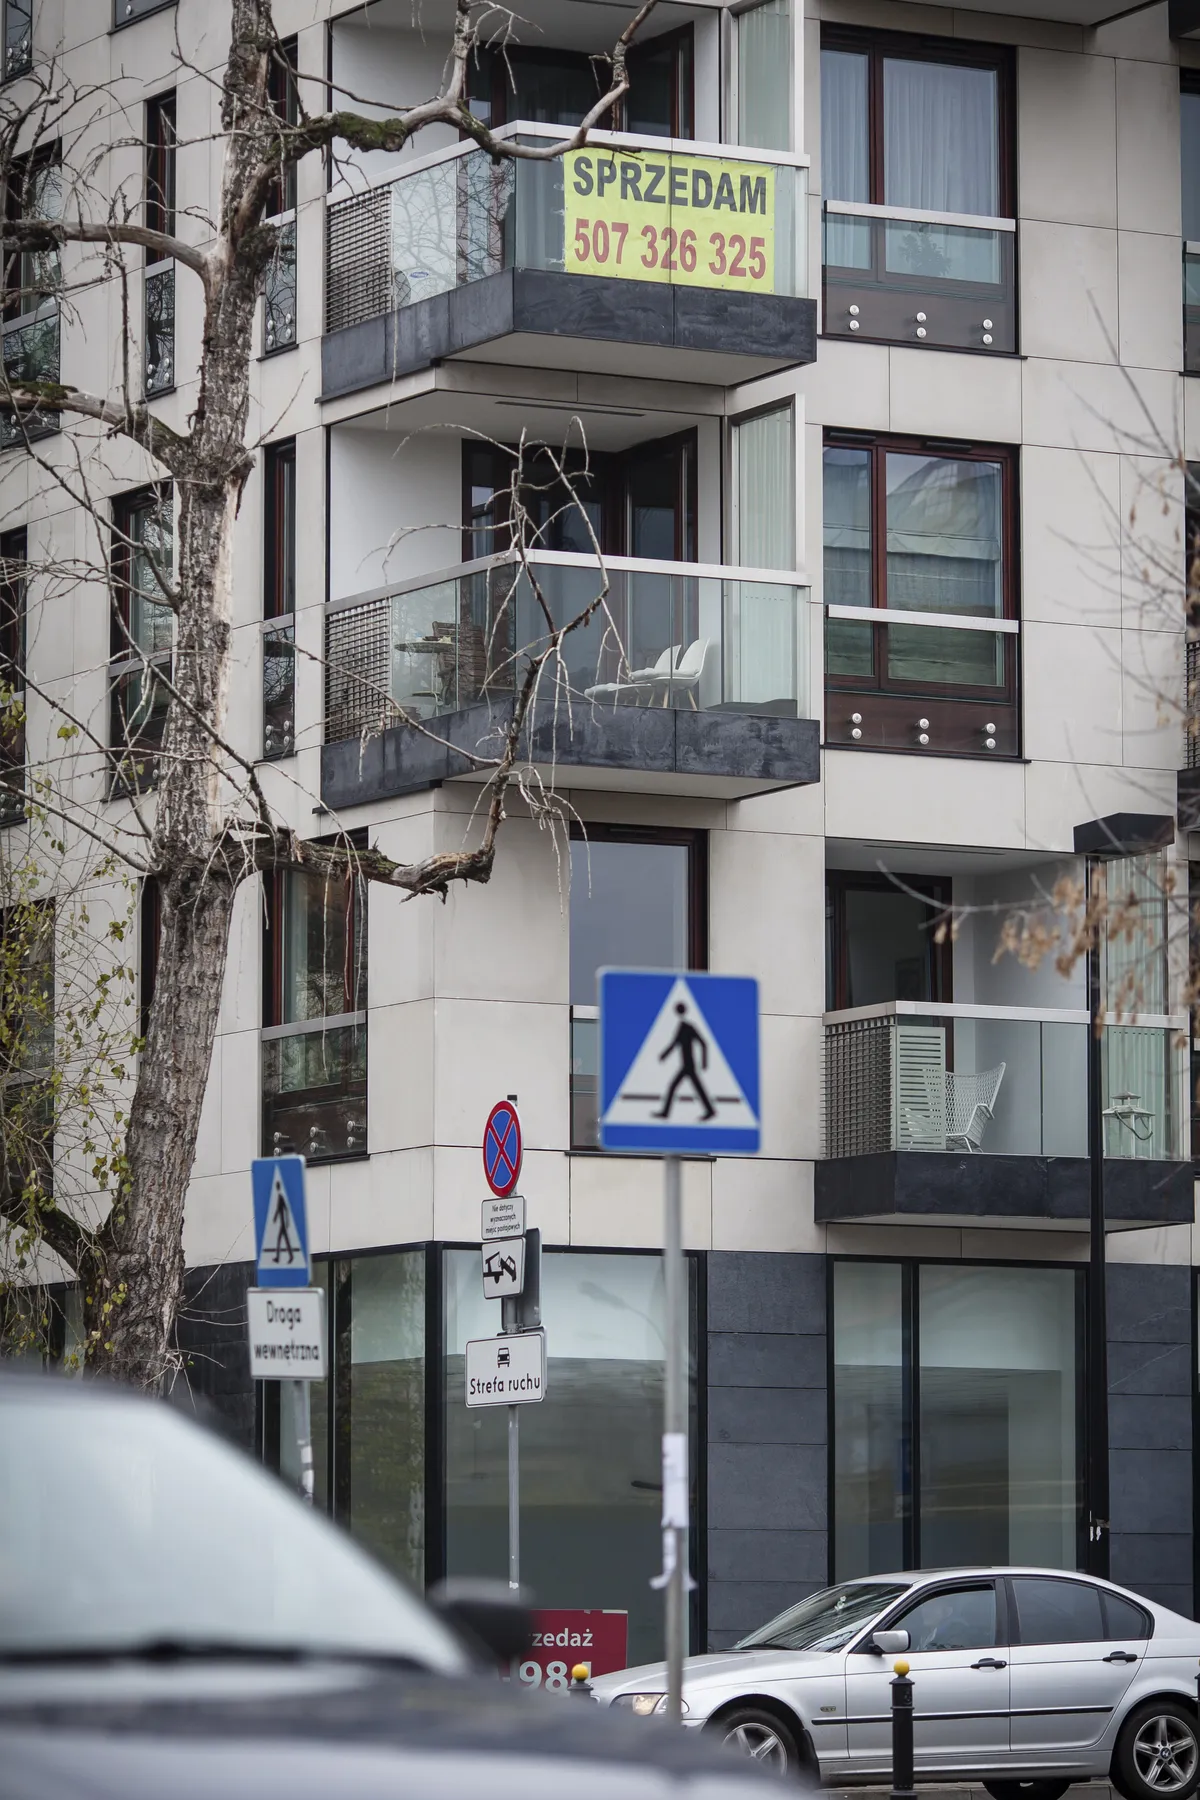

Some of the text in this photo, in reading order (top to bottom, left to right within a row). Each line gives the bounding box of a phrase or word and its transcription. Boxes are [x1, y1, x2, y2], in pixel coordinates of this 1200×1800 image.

[573, 156, 767, 215] SPRZEDAM
[574, 217, 766, 280] 507 326 325
[266, 1300, 302, 1330] Droga
[254, 1339, 319, 1366] wewnętrzna
[470, 1373, 540, 1396] Strefa ruchu
[529, 1627, 593, 1647] zedaż
